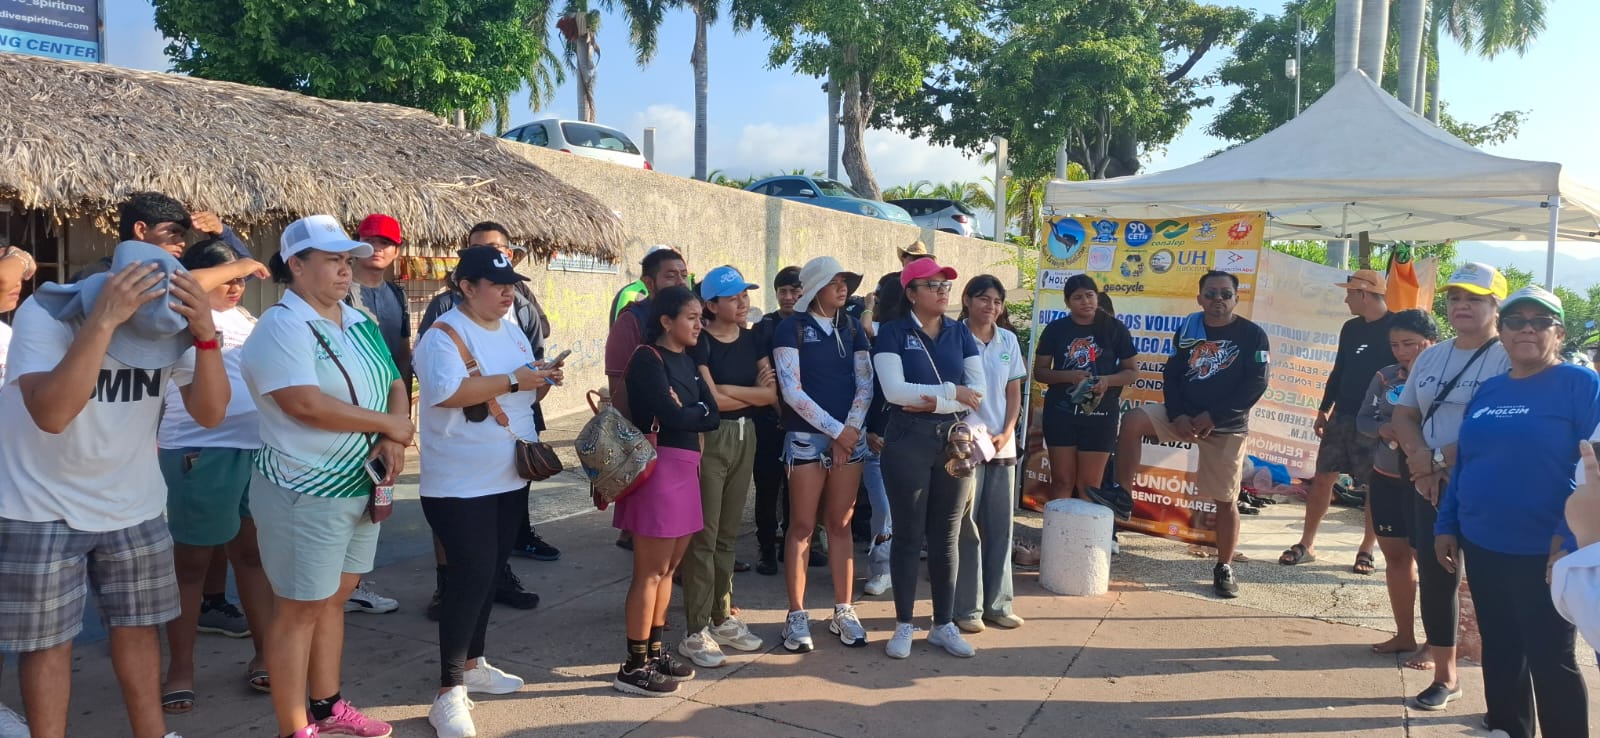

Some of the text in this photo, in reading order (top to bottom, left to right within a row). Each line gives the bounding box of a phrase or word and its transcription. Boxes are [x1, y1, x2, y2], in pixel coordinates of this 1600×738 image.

[0, 10, 89, 31] divespiritmx.com
[26, 38, 97, 58] CENTER
[1129, 223, 1144, 234] 90
[1178, 250, 1208, 265] UH
[1103, 282, 1144, 294] geocycle
[91, 368, 161, 403] MN
[1041, 457, 1051, 469] P
[1131, 490, 1217, 513] BENITO JUAREZ
